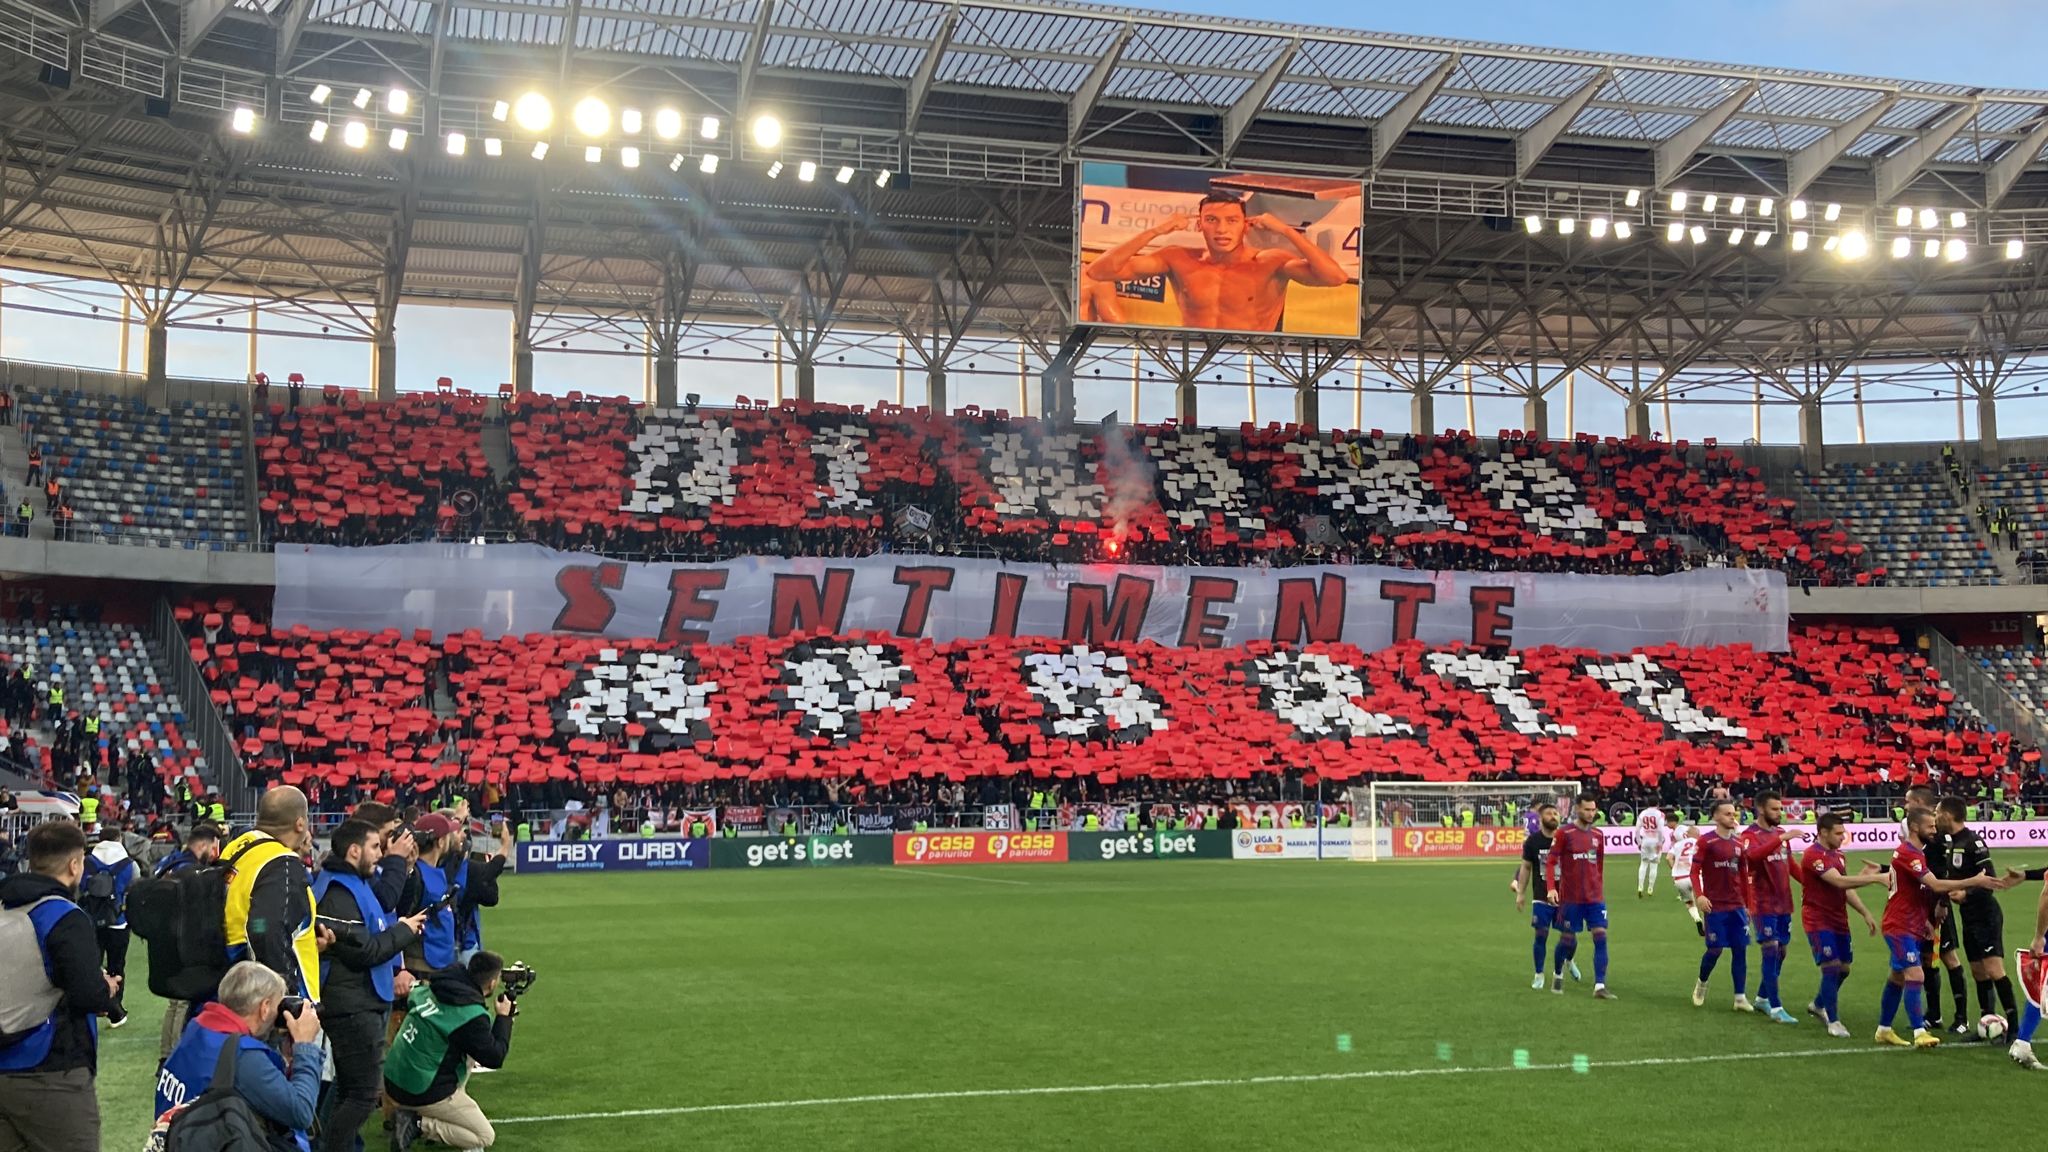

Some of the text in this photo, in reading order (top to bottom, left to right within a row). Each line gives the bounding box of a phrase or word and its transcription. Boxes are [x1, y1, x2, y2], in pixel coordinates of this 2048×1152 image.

[551, 563, 1515, 648] SENTIMENTE
[1990, 620, 2019, 632] 115
[1642, 816, 1657, 830] 99
[930, 835, 975, 850] casa
[1010, 835, 1055, 849] casa
[1160, 834, 1196, 853] bet
[1425, 830, 1465, 843] casa
[1496, 830, 1525, 843] cas
[528, 844, 603, 862] DURBY
[619, 842, 691, 860] DURBY
[813, 839, 853, 859] bet
[929, 850, 973, 859] pariurilor
[1009, 849, 1053, 858] pariurilor
[416, 998, 439, 1017] TV
[403, 1023, 418, 1044] 25
[157, 1068, 186, 1106] FOTO
